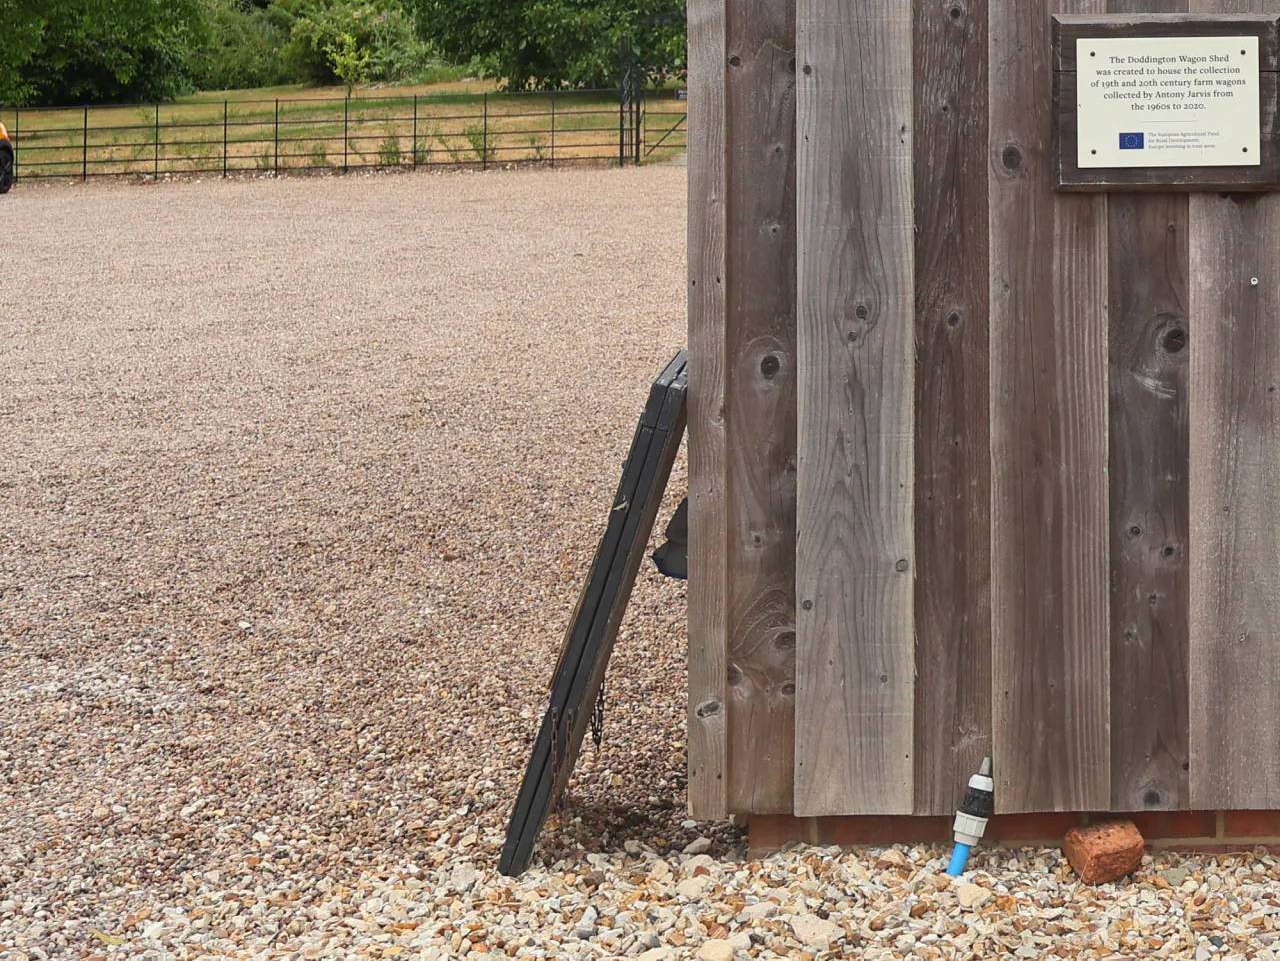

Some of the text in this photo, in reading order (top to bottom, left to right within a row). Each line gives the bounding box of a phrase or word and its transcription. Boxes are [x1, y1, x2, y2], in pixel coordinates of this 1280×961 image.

[1109, 54, 1229, 65] The Doddington Wagon Shed
[1113, 67, 1144, 75] created
[1157, 67, 1181, 75] house
[1199, 66, 1240, 74] collection
[1090, 80, 1099, 88] of
[1102, 79, 1119, 89] 19th
[1121, 79, 1136, 87] and
[1160, 79, 1192, 88] century
[1194, 78, 1213, 86] farm
[1215, 79, 1246, 87] wagons
[1103, 91, 1141, 99] collected
[1143, 91, 1153, 100] by
[1155, 91, 1185, 100] Antony
[1187, 90, 1211, 98] Jarvis
[1147, 103, 1170, 111] 1960s
